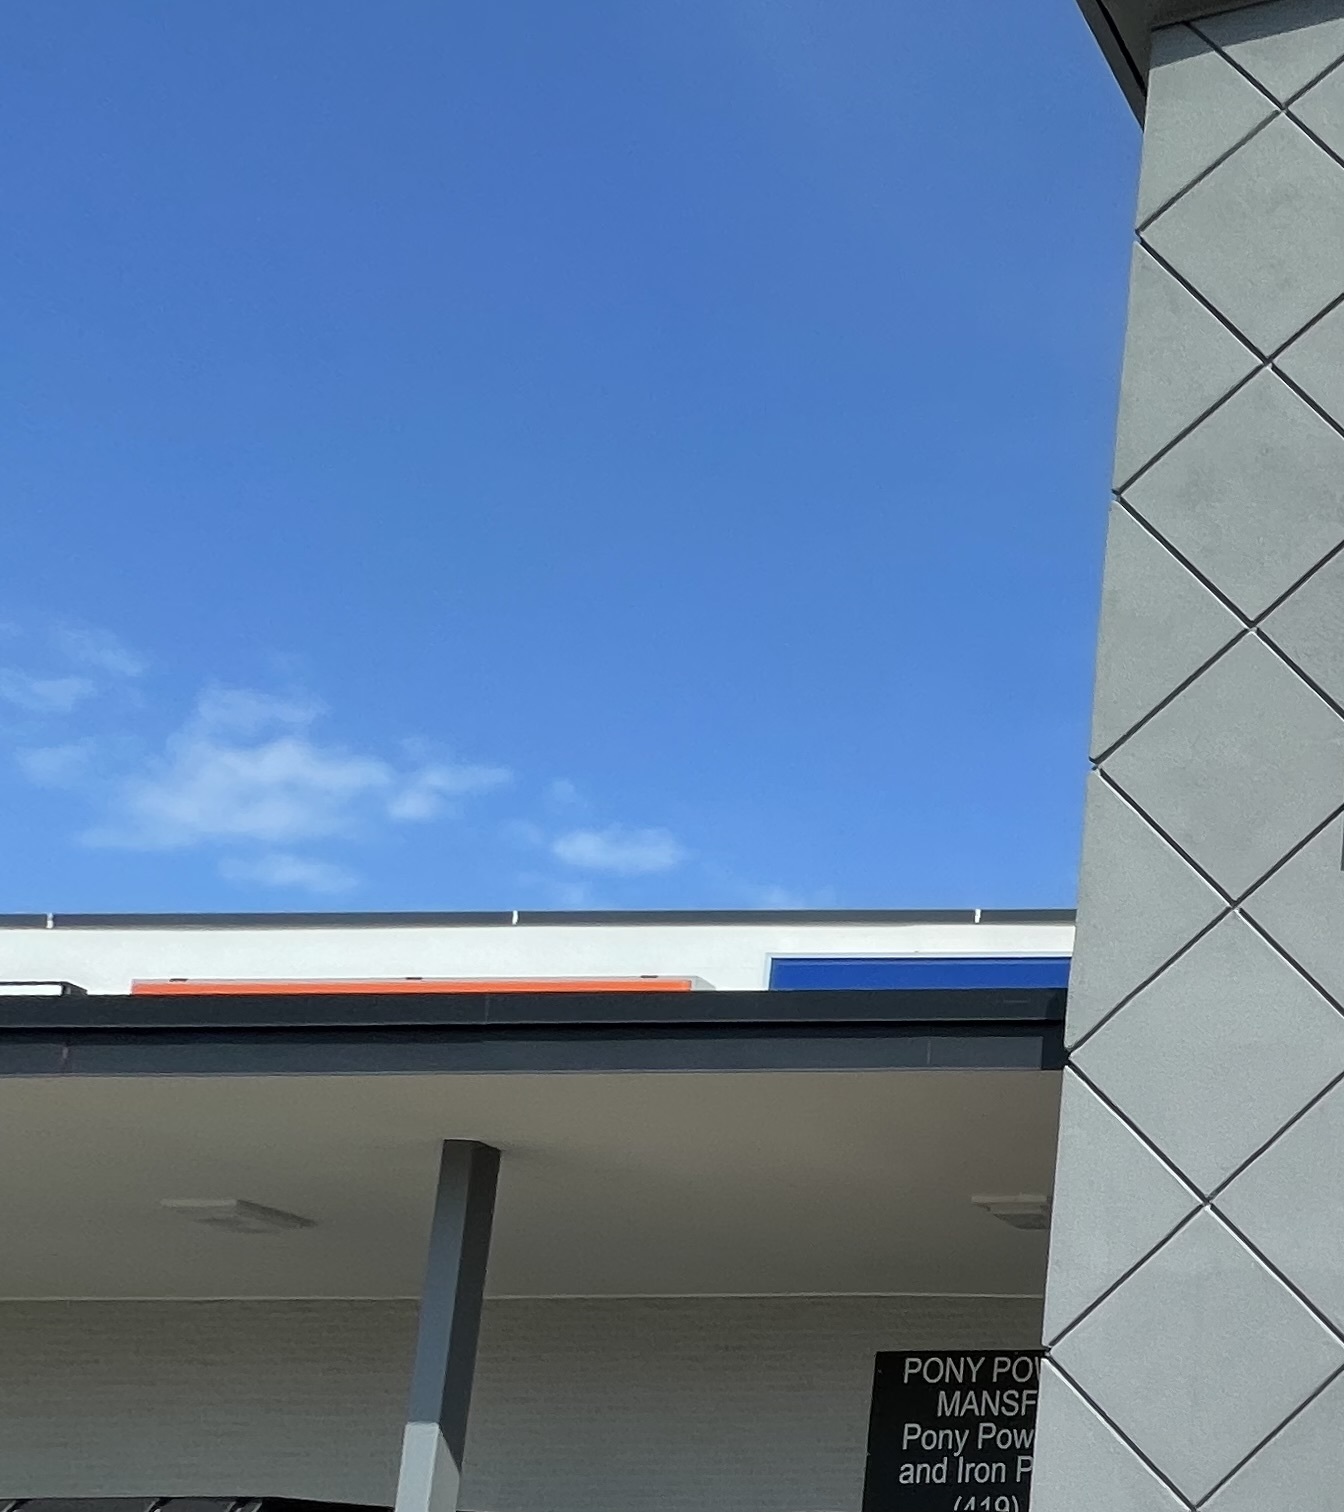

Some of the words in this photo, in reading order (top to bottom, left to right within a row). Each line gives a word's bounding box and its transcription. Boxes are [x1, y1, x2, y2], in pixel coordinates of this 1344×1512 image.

[904, 1357, 984, 1383] PONY
[937, 1390, 1037, 1416] MANSF
[903, 1423, 968, 1456] Pony
[899, 1457, 948, 1483] and
[957, 1456, 1005, 1483] Iron
